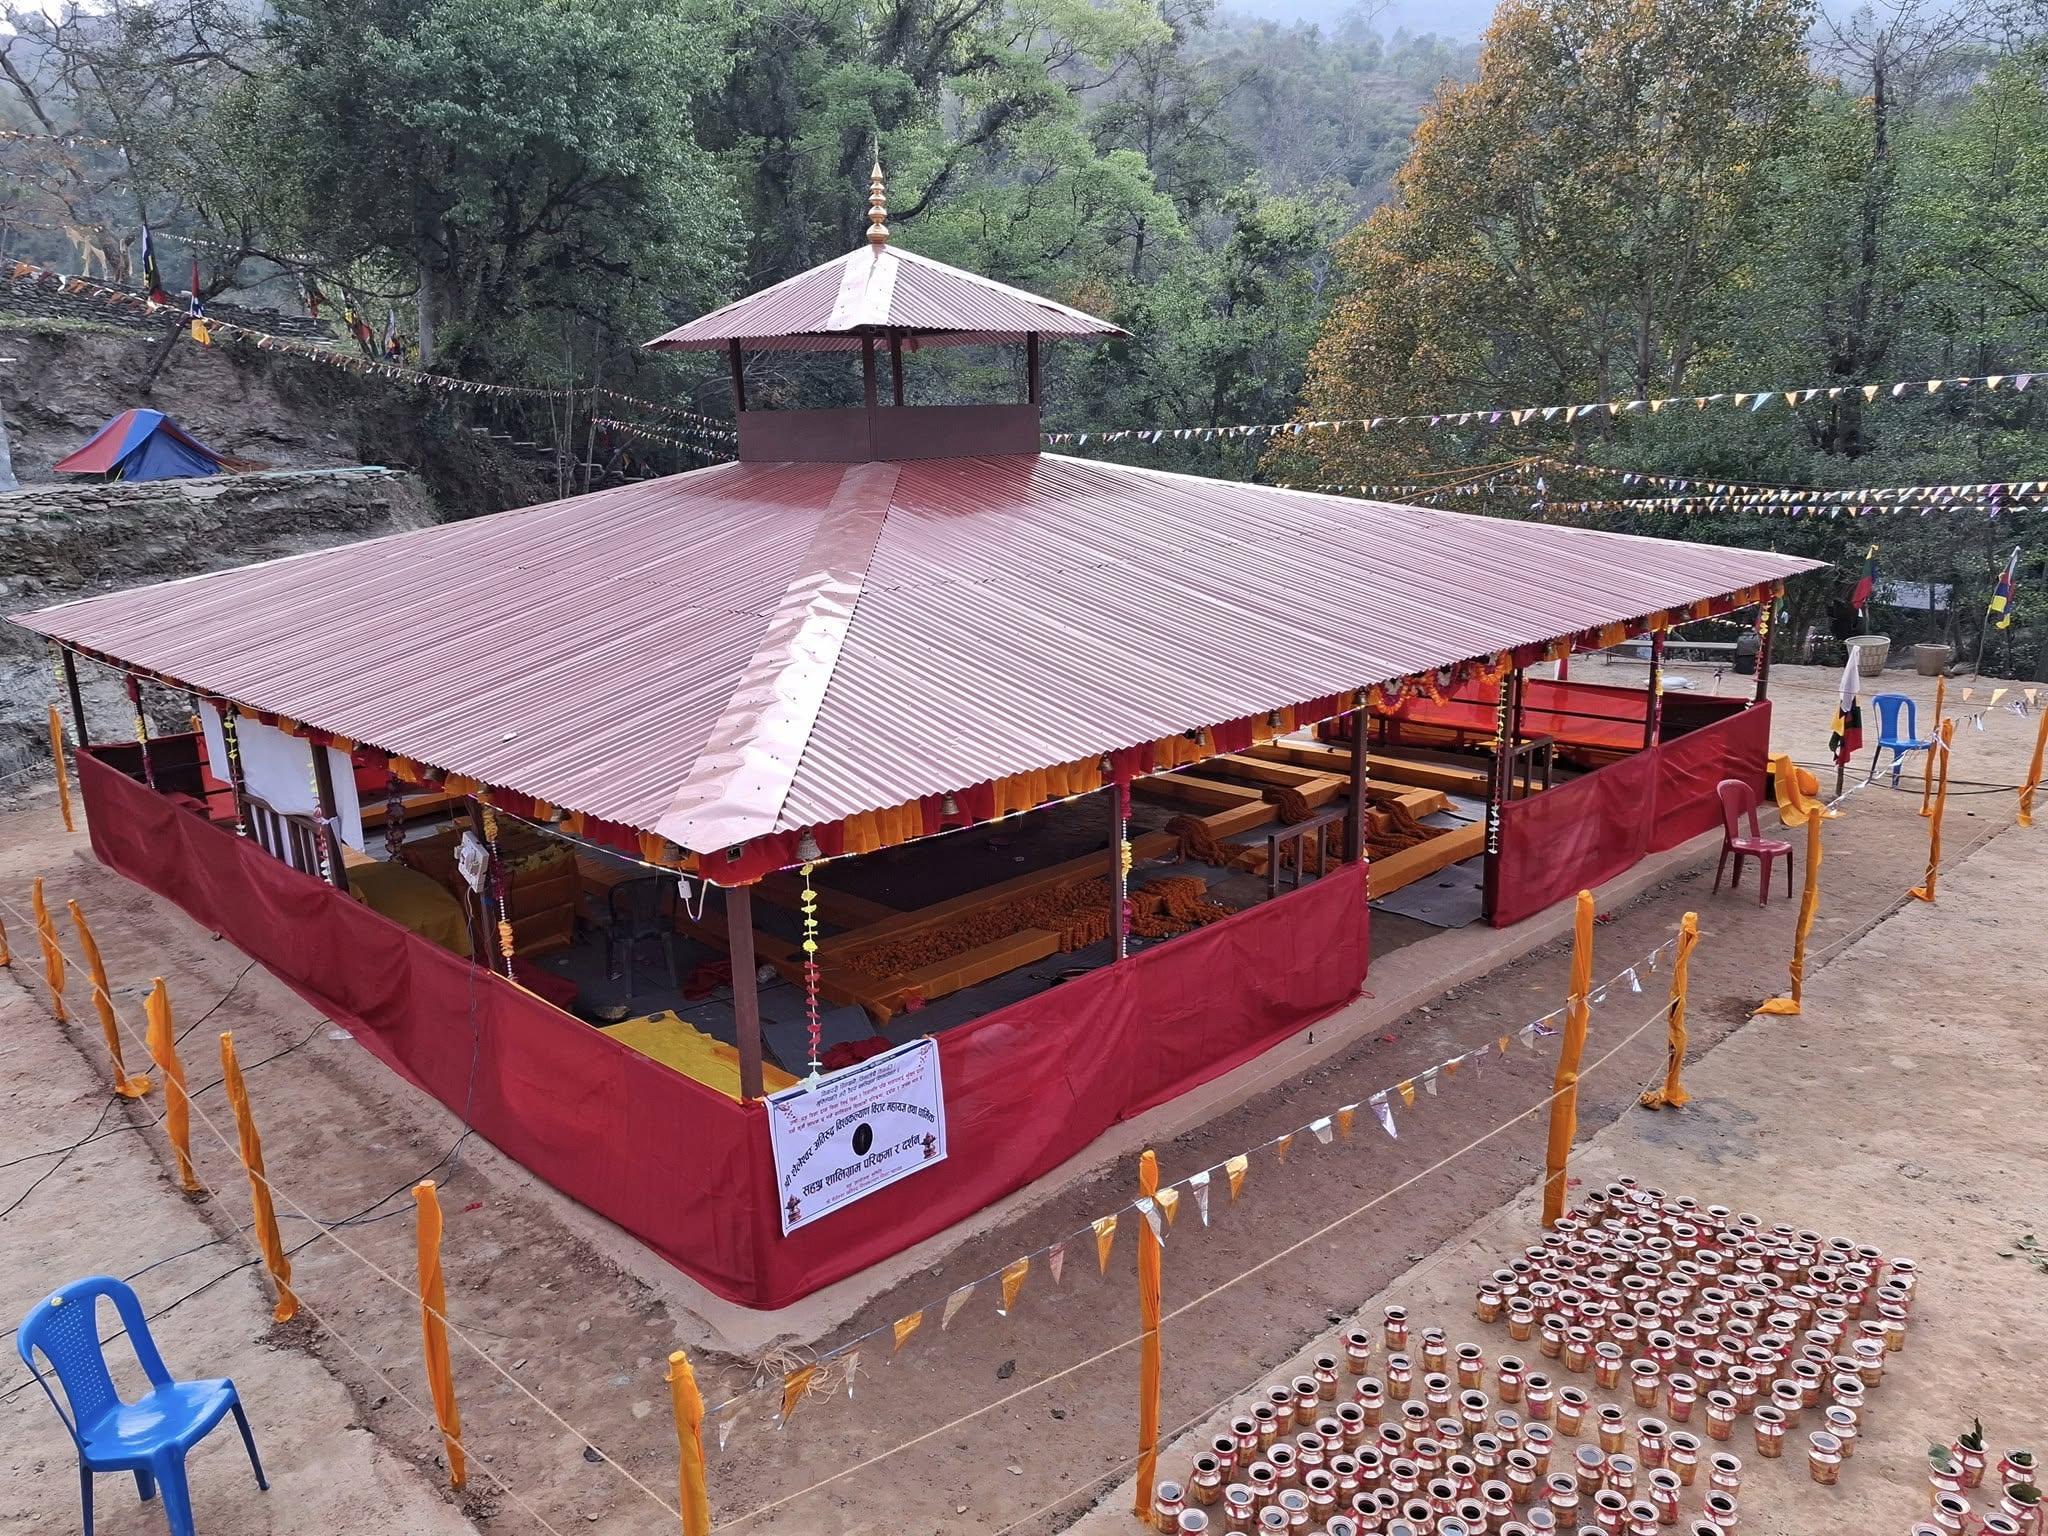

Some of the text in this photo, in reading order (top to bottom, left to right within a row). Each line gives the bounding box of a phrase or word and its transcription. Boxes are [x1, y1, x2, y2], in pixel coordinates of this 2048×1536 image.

[871, 1102, 886, 1114] विराट
[825, 1162, 861, 1186] शालिग्राम
[863, 1147, 893, 1169] परिक्रमा
[894, 1144, 900, 1154] र
